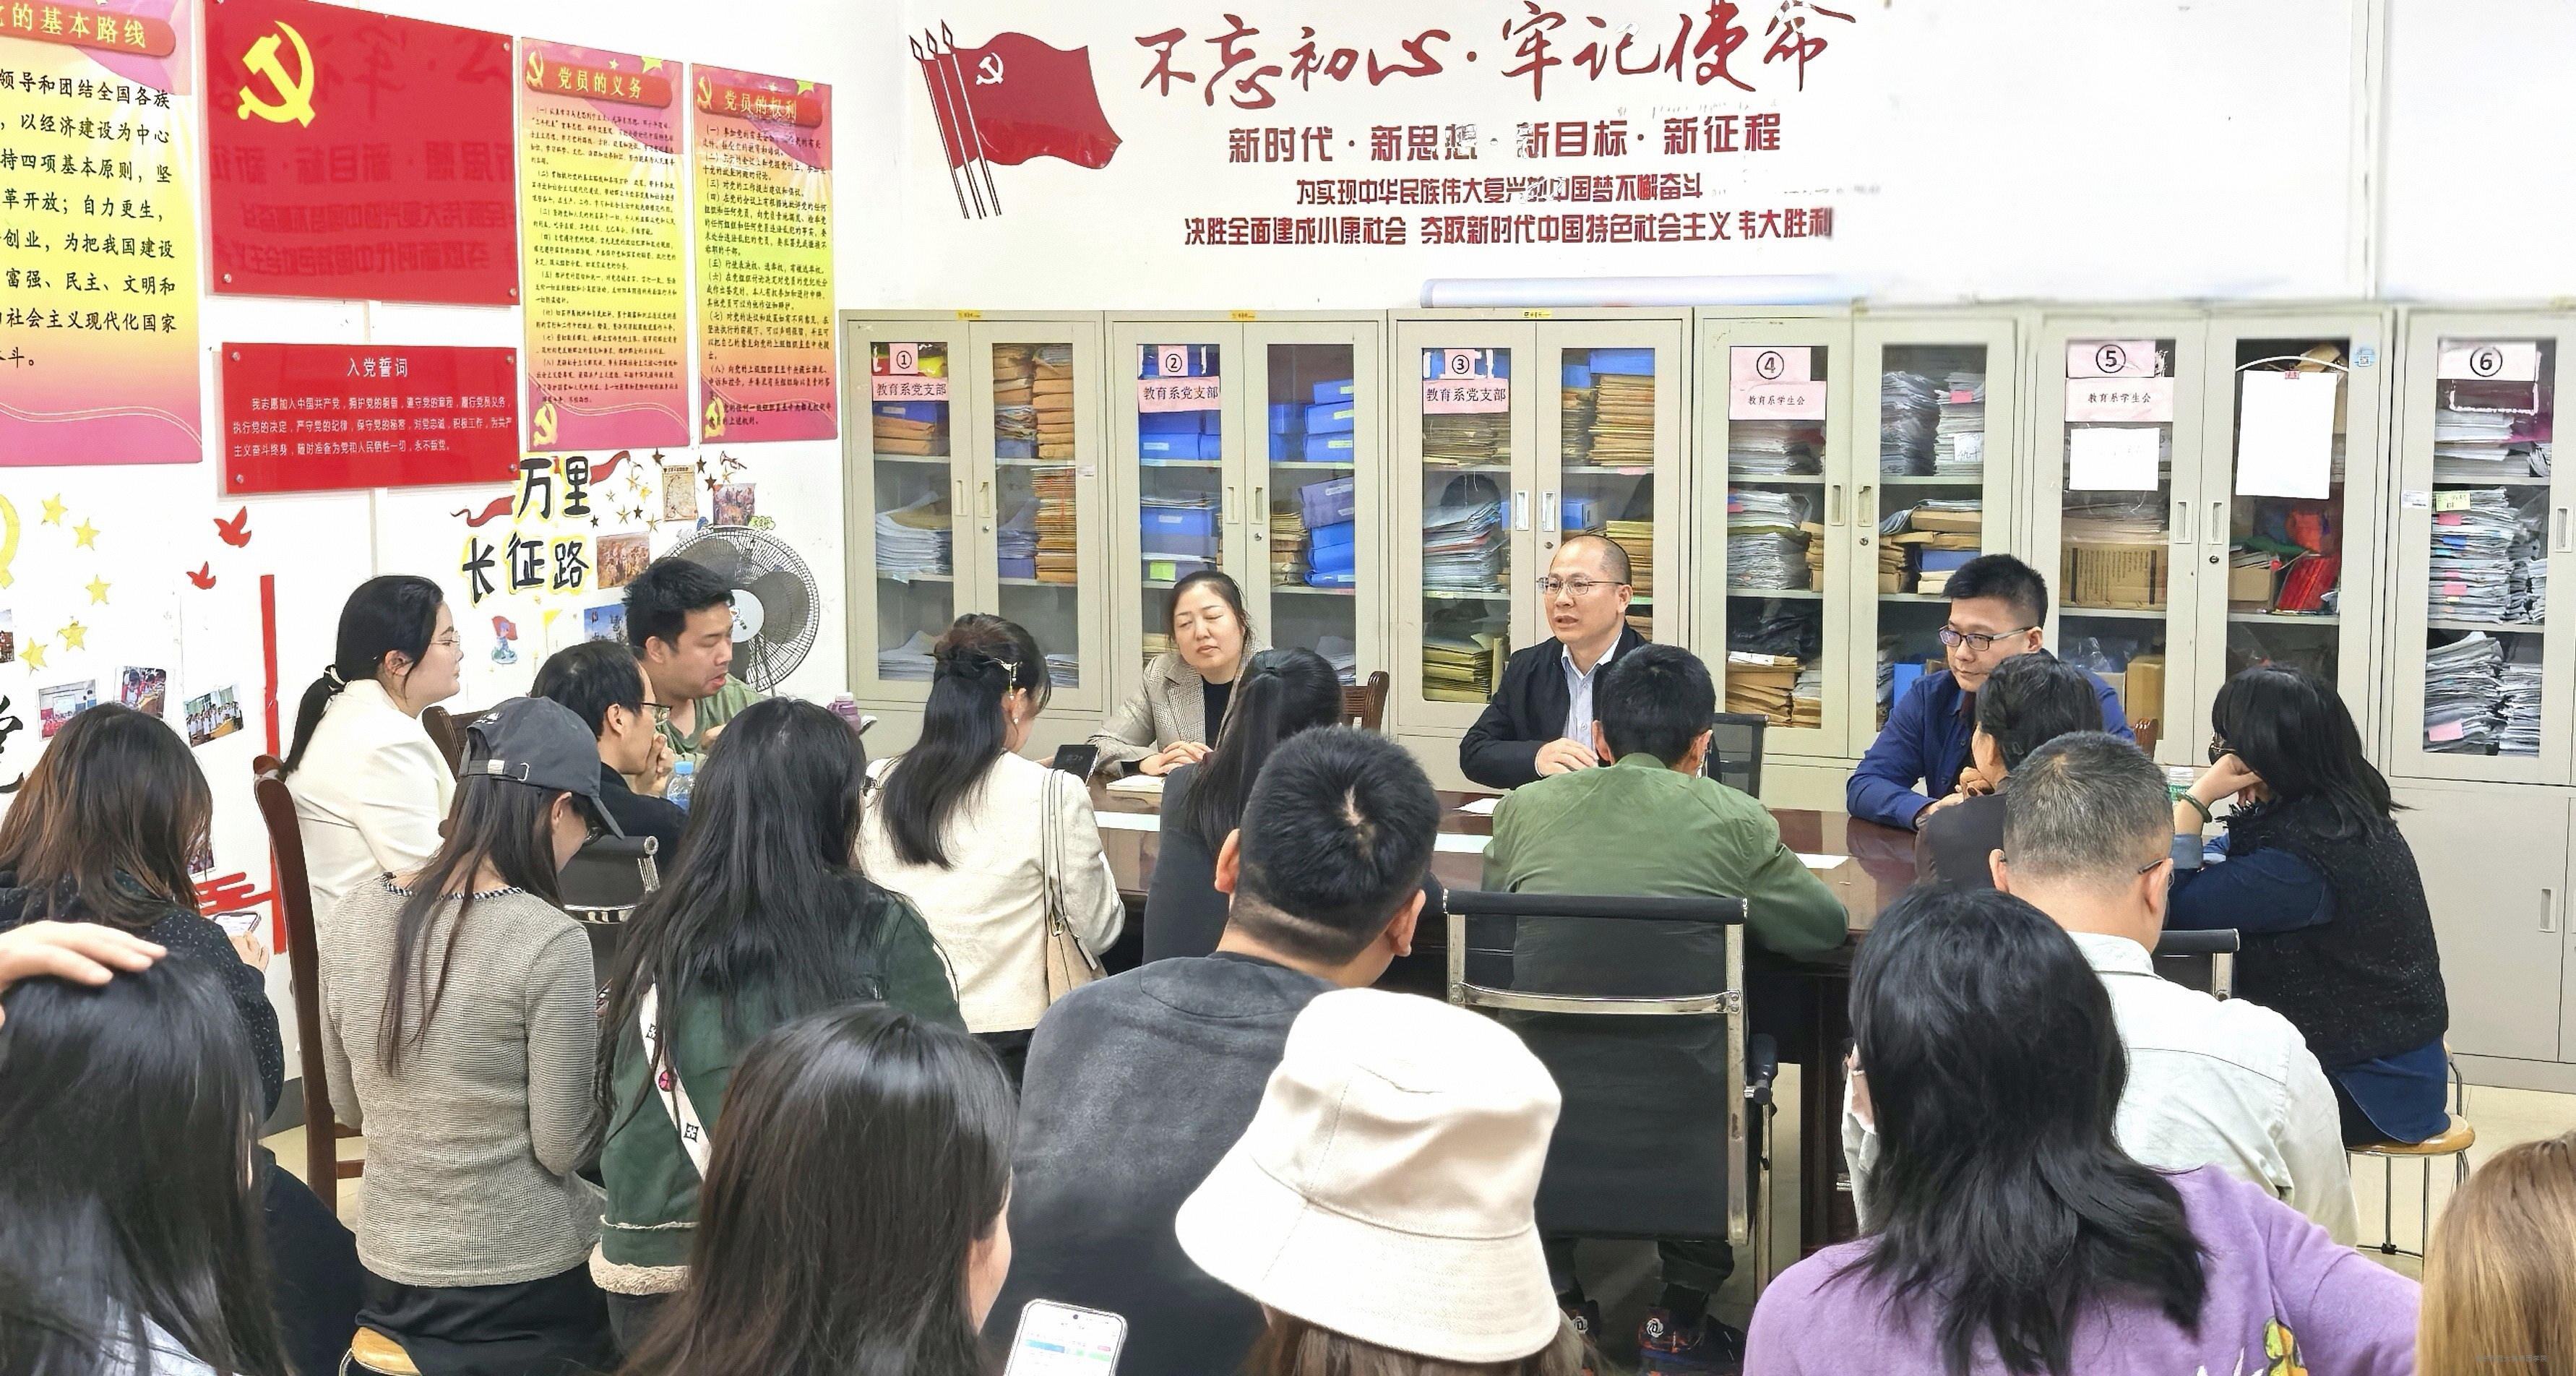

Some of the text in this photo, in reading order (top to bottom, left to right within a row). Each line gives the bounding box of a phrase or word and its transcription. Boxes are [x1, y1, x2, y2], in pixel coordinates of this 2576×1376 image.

[0, 2, 146, 48] 的基本路线
[558, 66, 642, 99] 党员的义务
[725, 90, 796, 121] 党员的权利
[0, 148, 172, 183] 持四项基本原则，坚
[2, 188, 163, 222] 革开放；自力更生，
[0, 228, 175, 259] 创业，为把我国建设
[1185, 217, 1406, 245] 决胜全面建成小康社会
[6, 267, 176, 296] 富强、民主、文明和
[0, 307, 177, 334] 社会主义现代化国家
[0, 346, 35, 369] 斗。
[347, 356, 408, 377] 入党誓词
[876, 382, 947, 396] 教育系党支部
[1143, 386, 1218, 400] 教育系党支部
[1426, 387, 1507, 402] 教育系党支部
[517, 455, 592, 520] 万里
[462, 531, 590, 604] 长征路
